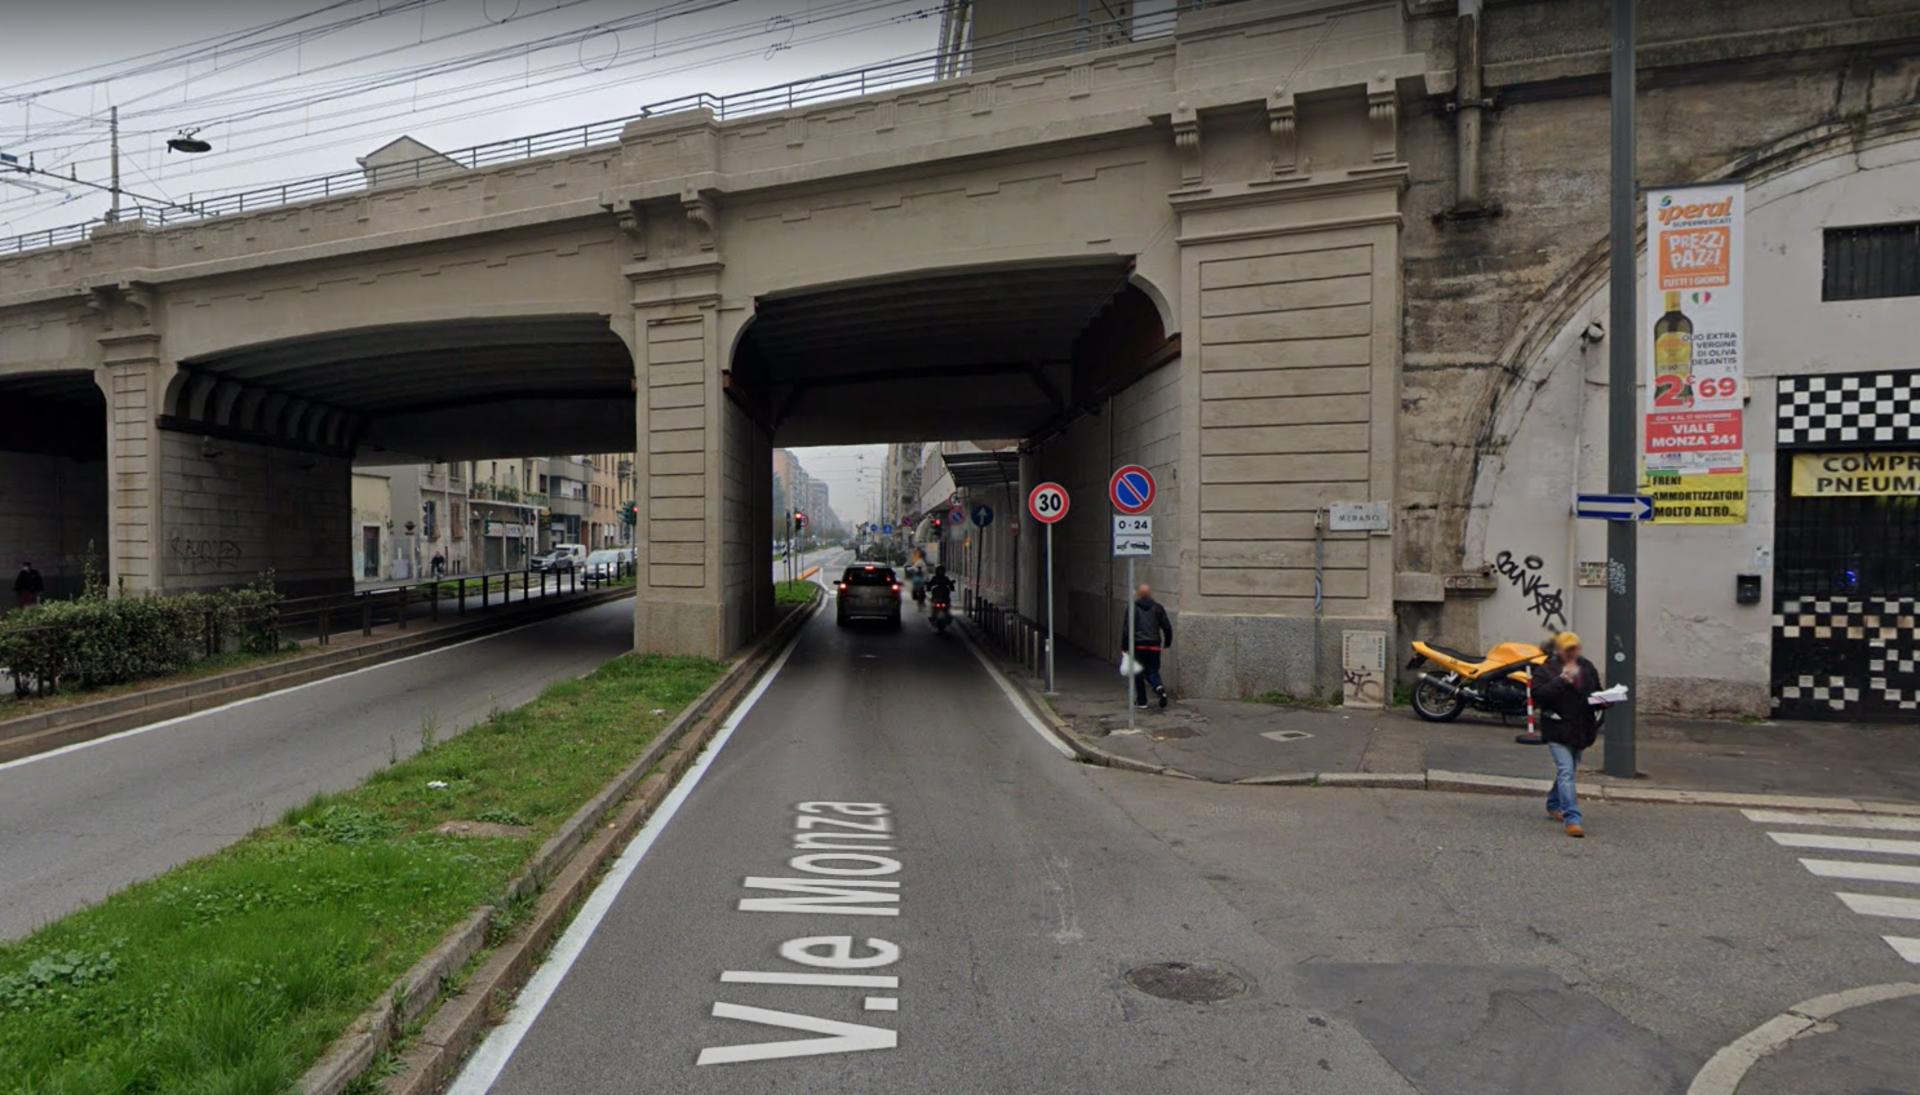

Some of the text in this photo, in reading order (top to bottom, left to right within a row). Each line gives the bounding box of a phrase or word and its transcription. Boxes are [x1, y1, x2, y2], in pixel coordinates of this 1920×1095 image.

[1672, 217, 1732, 228] SUPERMERCATI
[1669, 231, 1725, 252] PREZZI
[1670, 248, 1721, 269] PAZZI
[1663, 277, 1688, 287] TUTTI
[1682, 332, 1737, 342] OLIO EXTRA
[1696, 340, 1737, 349] VERGINE
[1697, 348, 1737, 358] DI OLIVA
[1691, 357, 1737, 366] DESANTIS
[1672, 423, 1715, 434] VIALE
[1652, 434, 1737, 448] MONZA 241
[1817, 476, 1920, 492] PNEUM
[1039, 493, 1061, 512] 30
[1654, 506, 1692, 517] MOLTO
[696, 801, 902, 1066] V.le Monza
